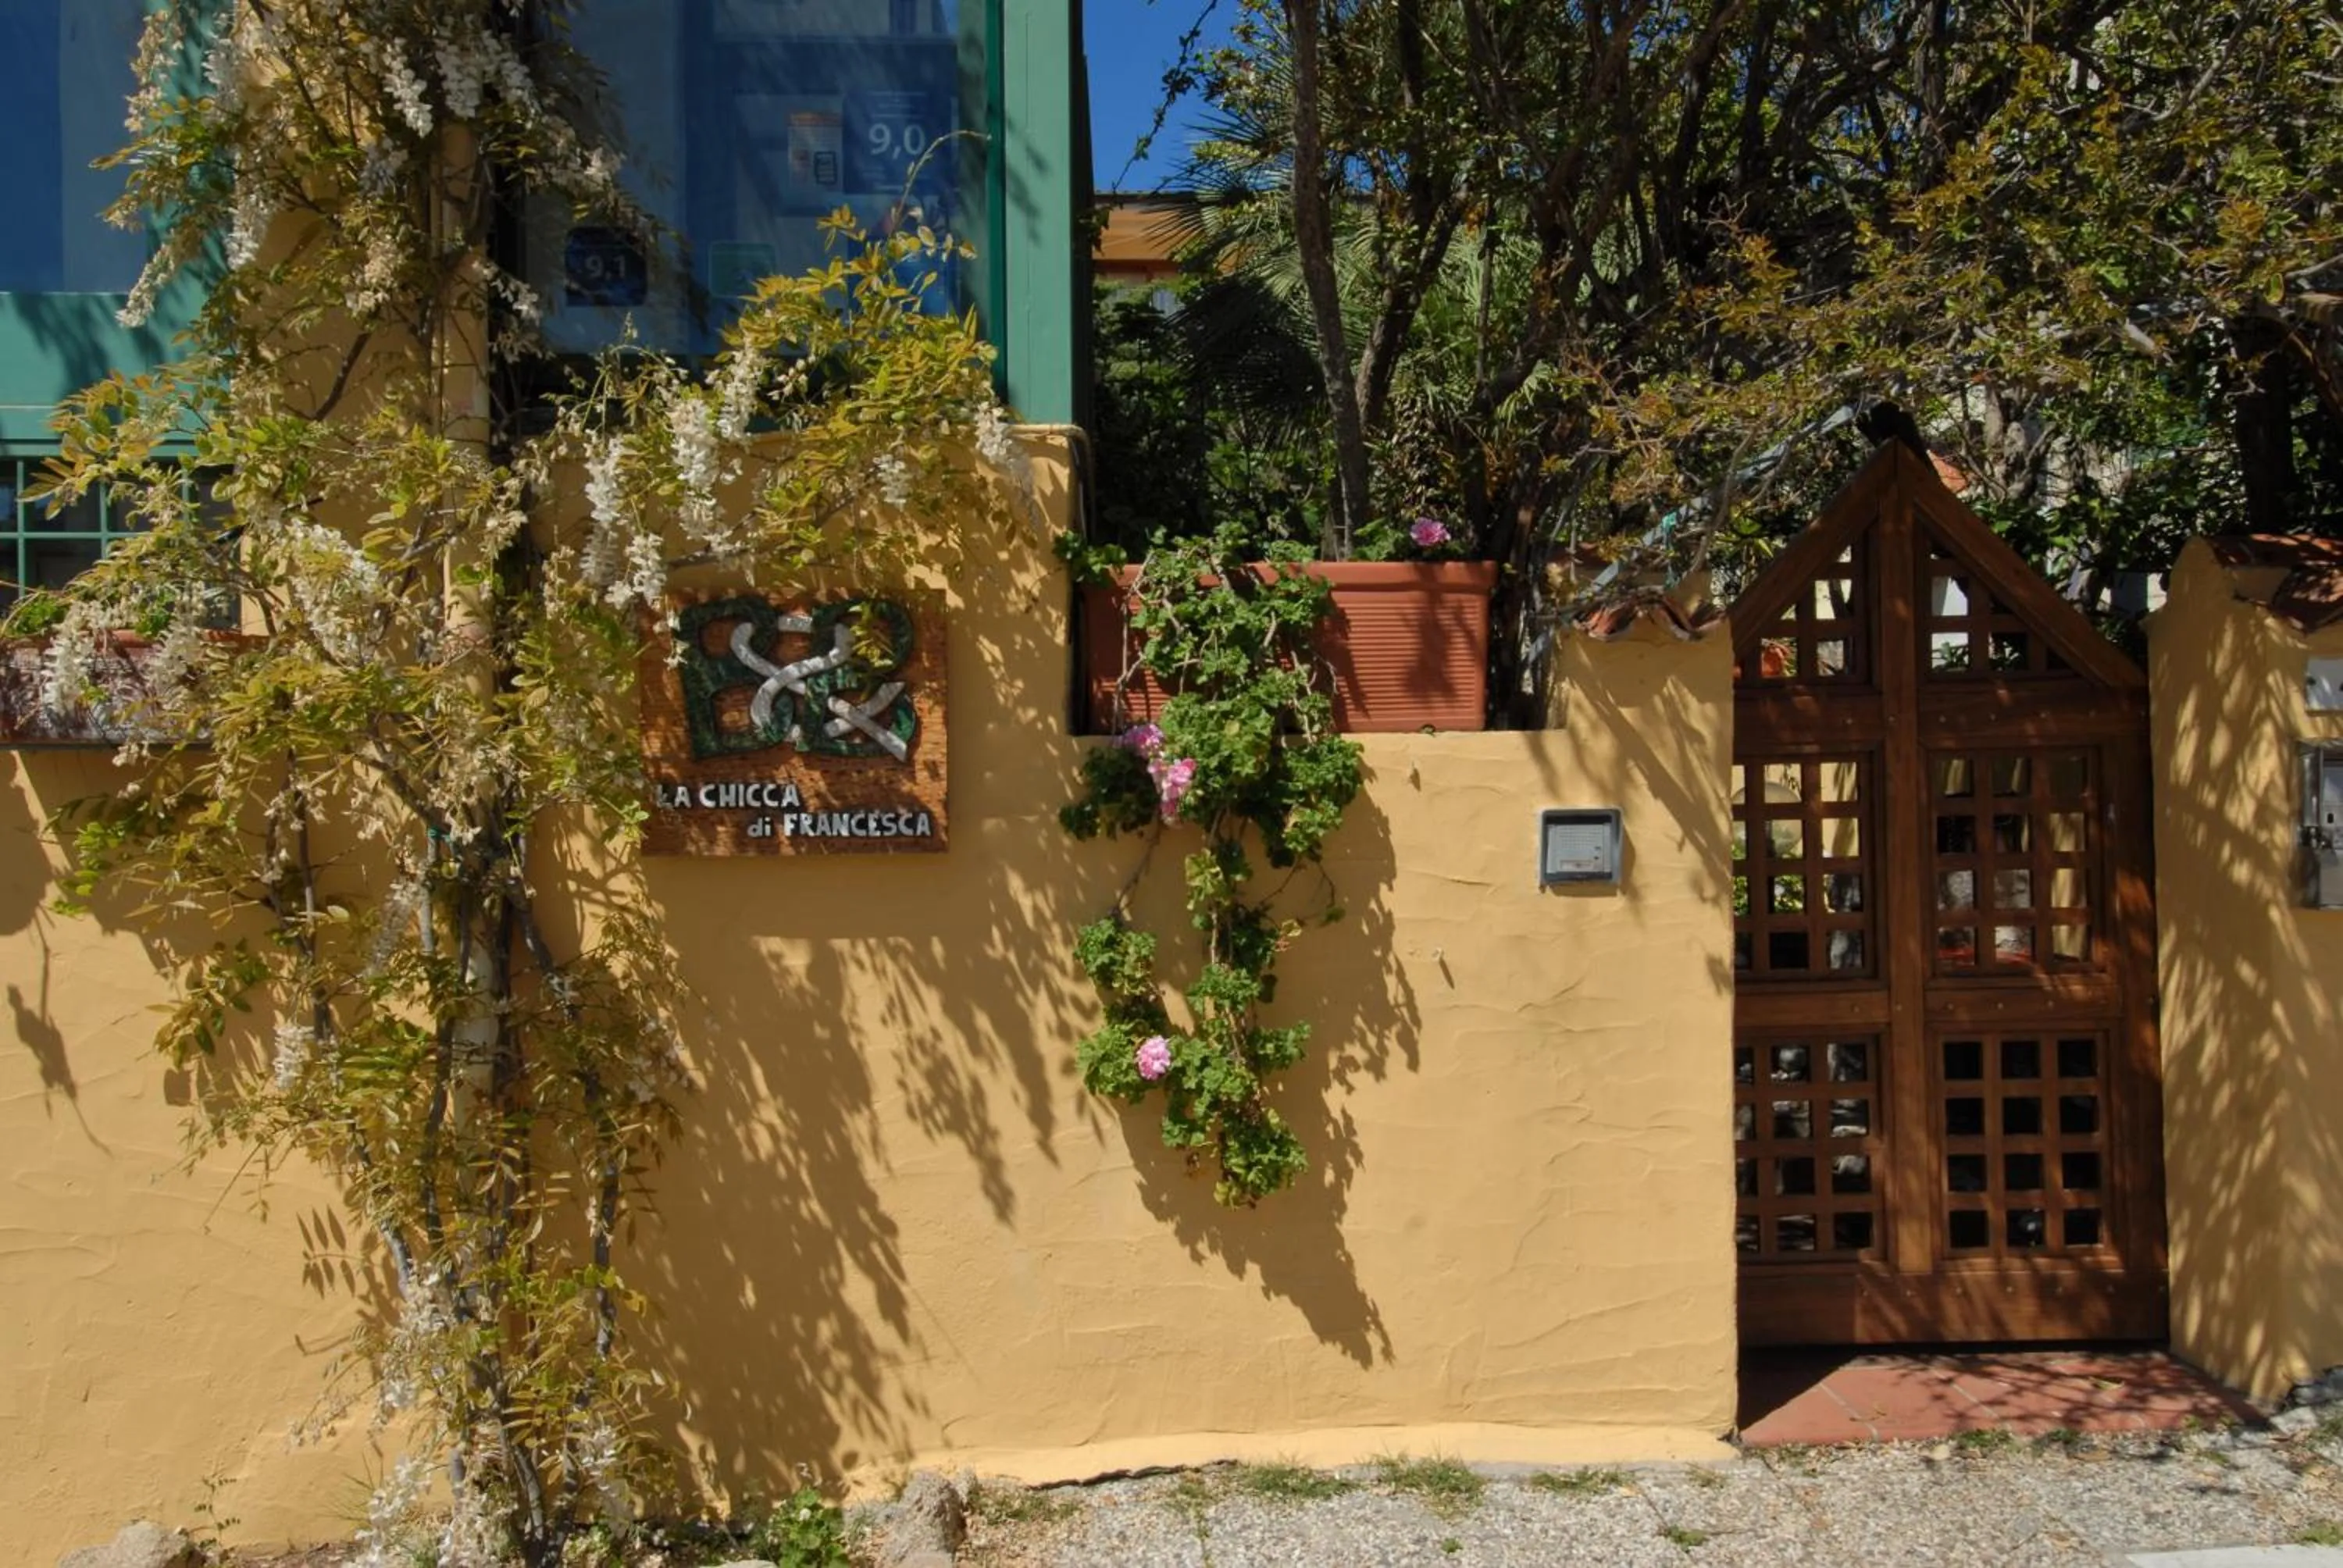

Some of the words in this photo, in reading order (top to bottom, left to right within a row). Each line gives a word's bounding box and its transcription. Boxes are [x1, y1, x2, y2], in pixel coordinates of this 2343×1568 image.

[868, 123, 925, 160] 9,0
[656, 784, 692, 809] LA
[698, 783, 801, 808] CHICCA
[747, 817, 772, 838] di
[783, 812, 932, 837] FRANCESCA
